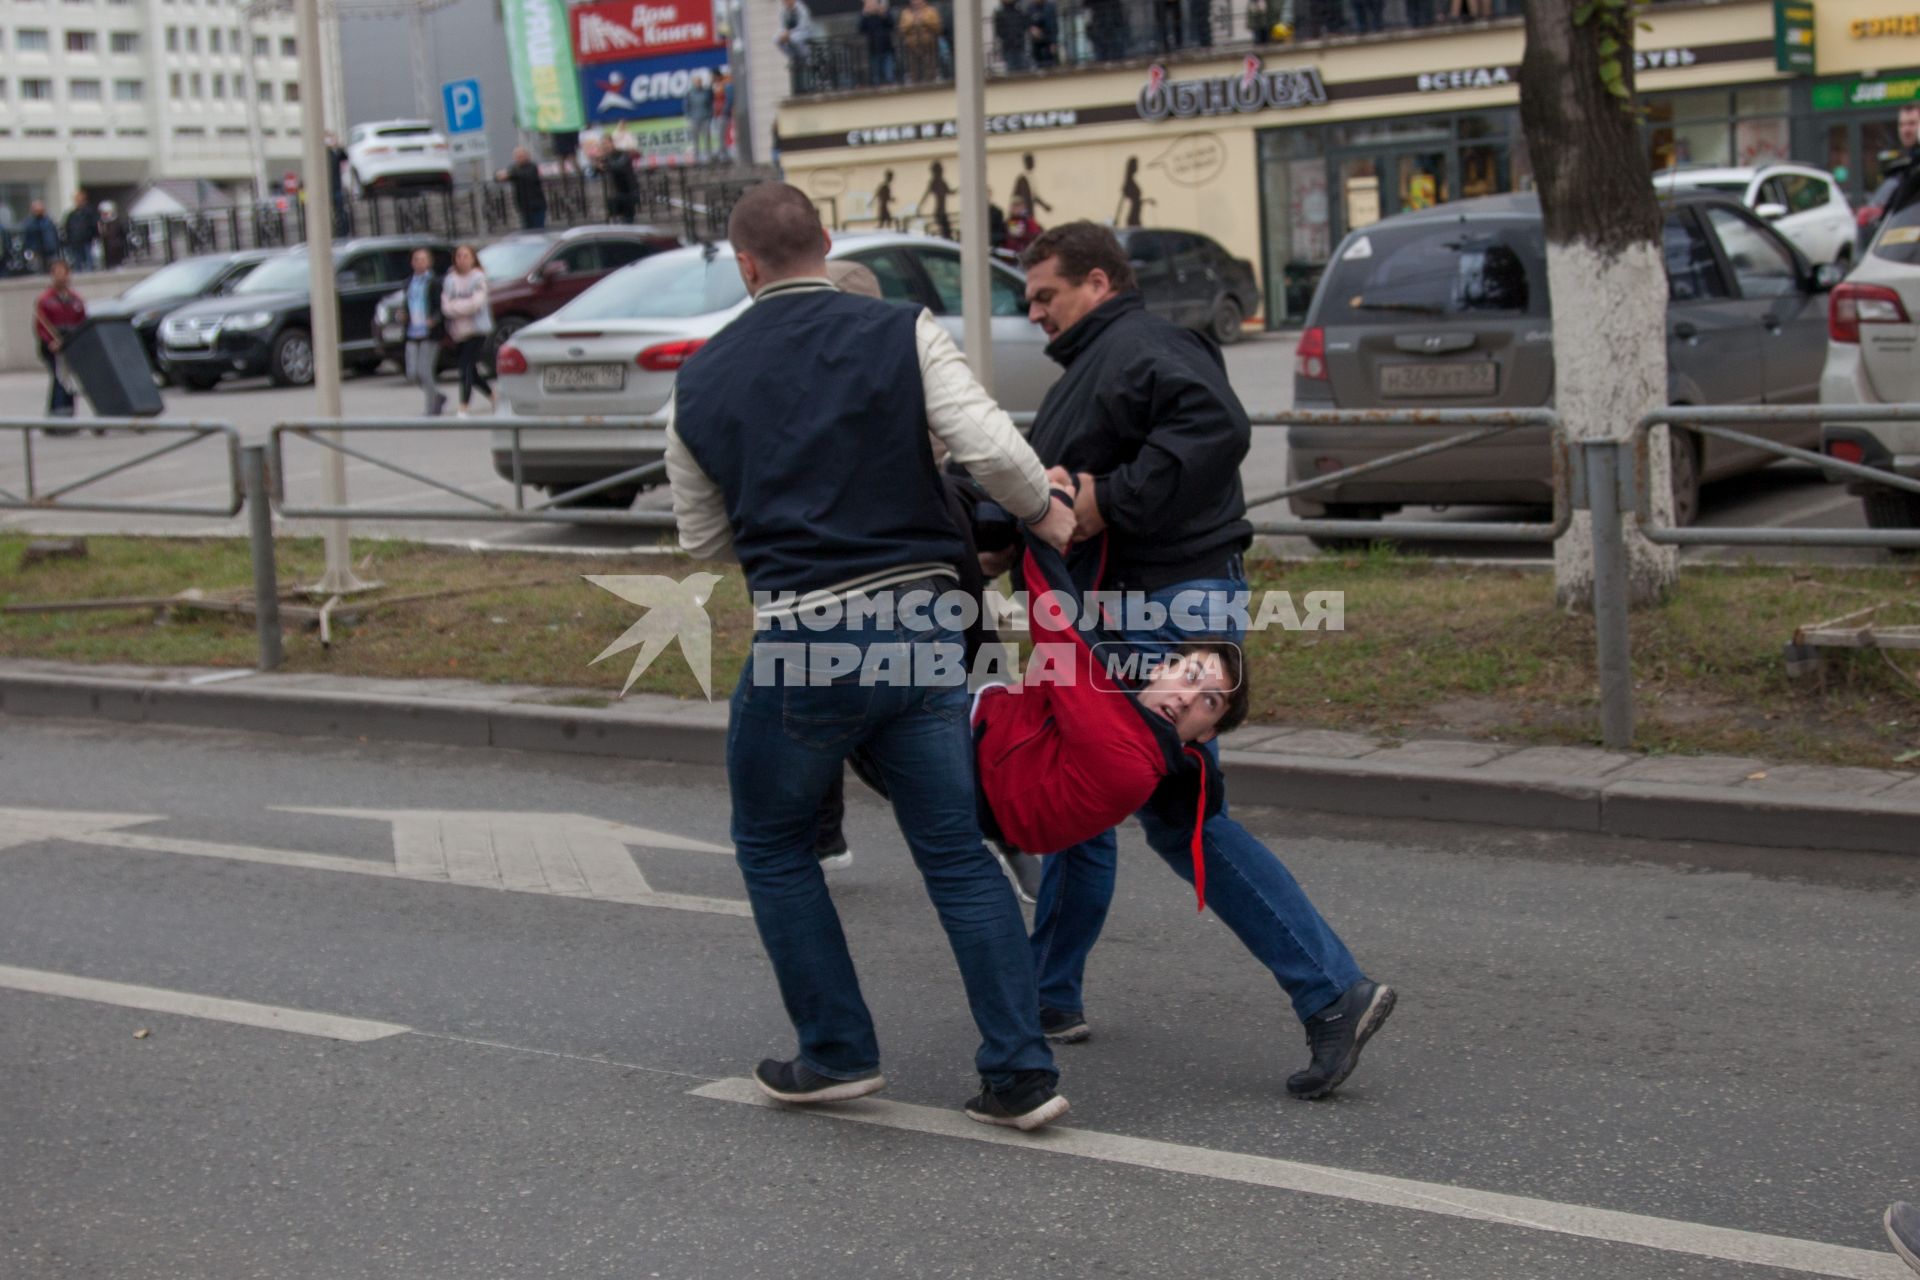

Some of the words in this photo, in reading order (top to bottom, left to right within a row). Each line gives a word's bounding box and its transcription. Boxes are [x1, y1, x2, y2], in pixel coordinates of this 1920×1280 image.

[1633, 47, 1697, 70] БУВЬ
[1137, 54, 1328, 123] ОБНОВА
[1417, 67, 1510, 91] ВСЕГДА
[942, 110, 1077, 137] АЕССУАРЫ
